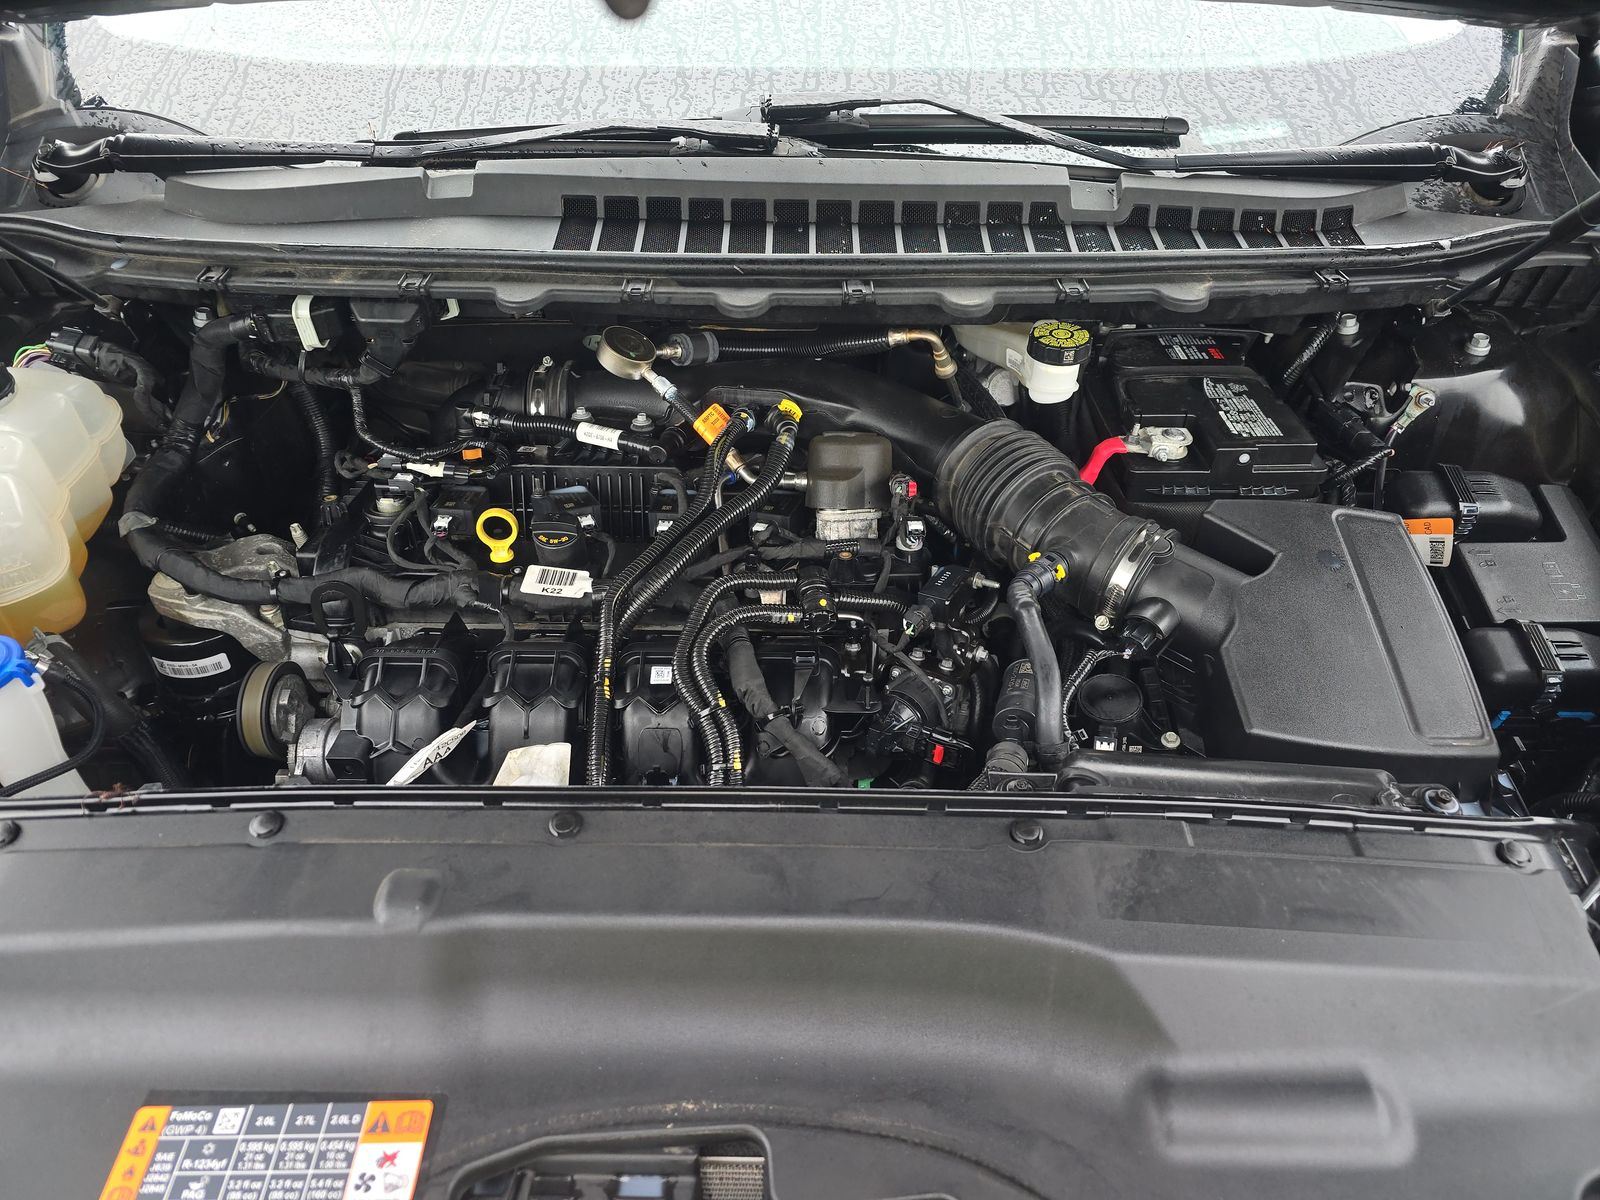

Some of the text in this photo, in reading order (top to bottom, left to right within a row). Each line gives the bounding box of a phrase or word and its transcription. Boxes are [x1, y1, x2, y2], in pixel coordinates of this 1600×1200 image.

[424, 746, 451, 768] AAA
[170, 1110, 214, 1122] FoMoCo
[254, 1115, 276, 1126] 2.0L
[295, 1114, 316, 1126] 2.7L
[162, 1124, 194, 1136] (GWP
[182, 1158, 228, 1170] R-1234yf
